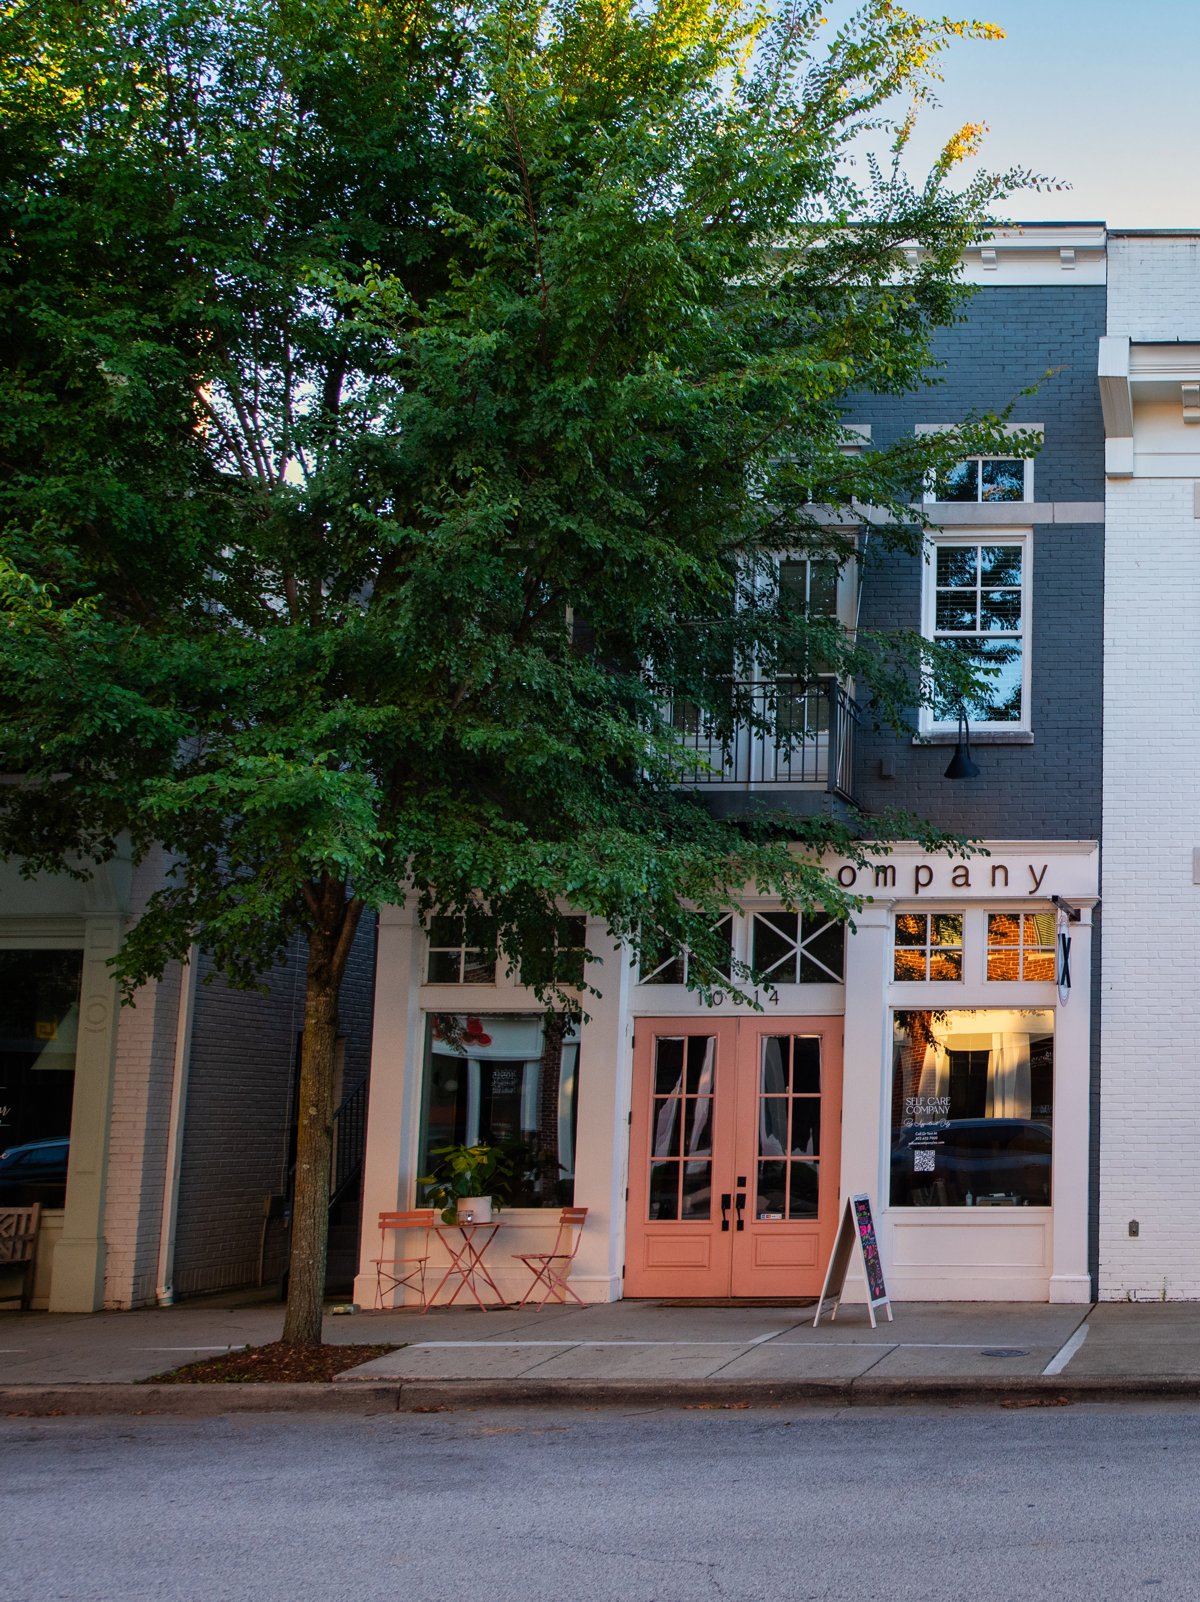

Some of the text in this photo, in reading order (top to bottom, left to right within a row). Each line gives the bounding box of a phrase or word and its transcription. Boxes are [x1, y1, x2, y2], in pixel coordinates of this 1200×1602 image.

[837, 864, 1048, 894] ompany
[905, 1096, 951, 1106] SELF CARE
[905, 1105, 951, 1115] COMPANY
